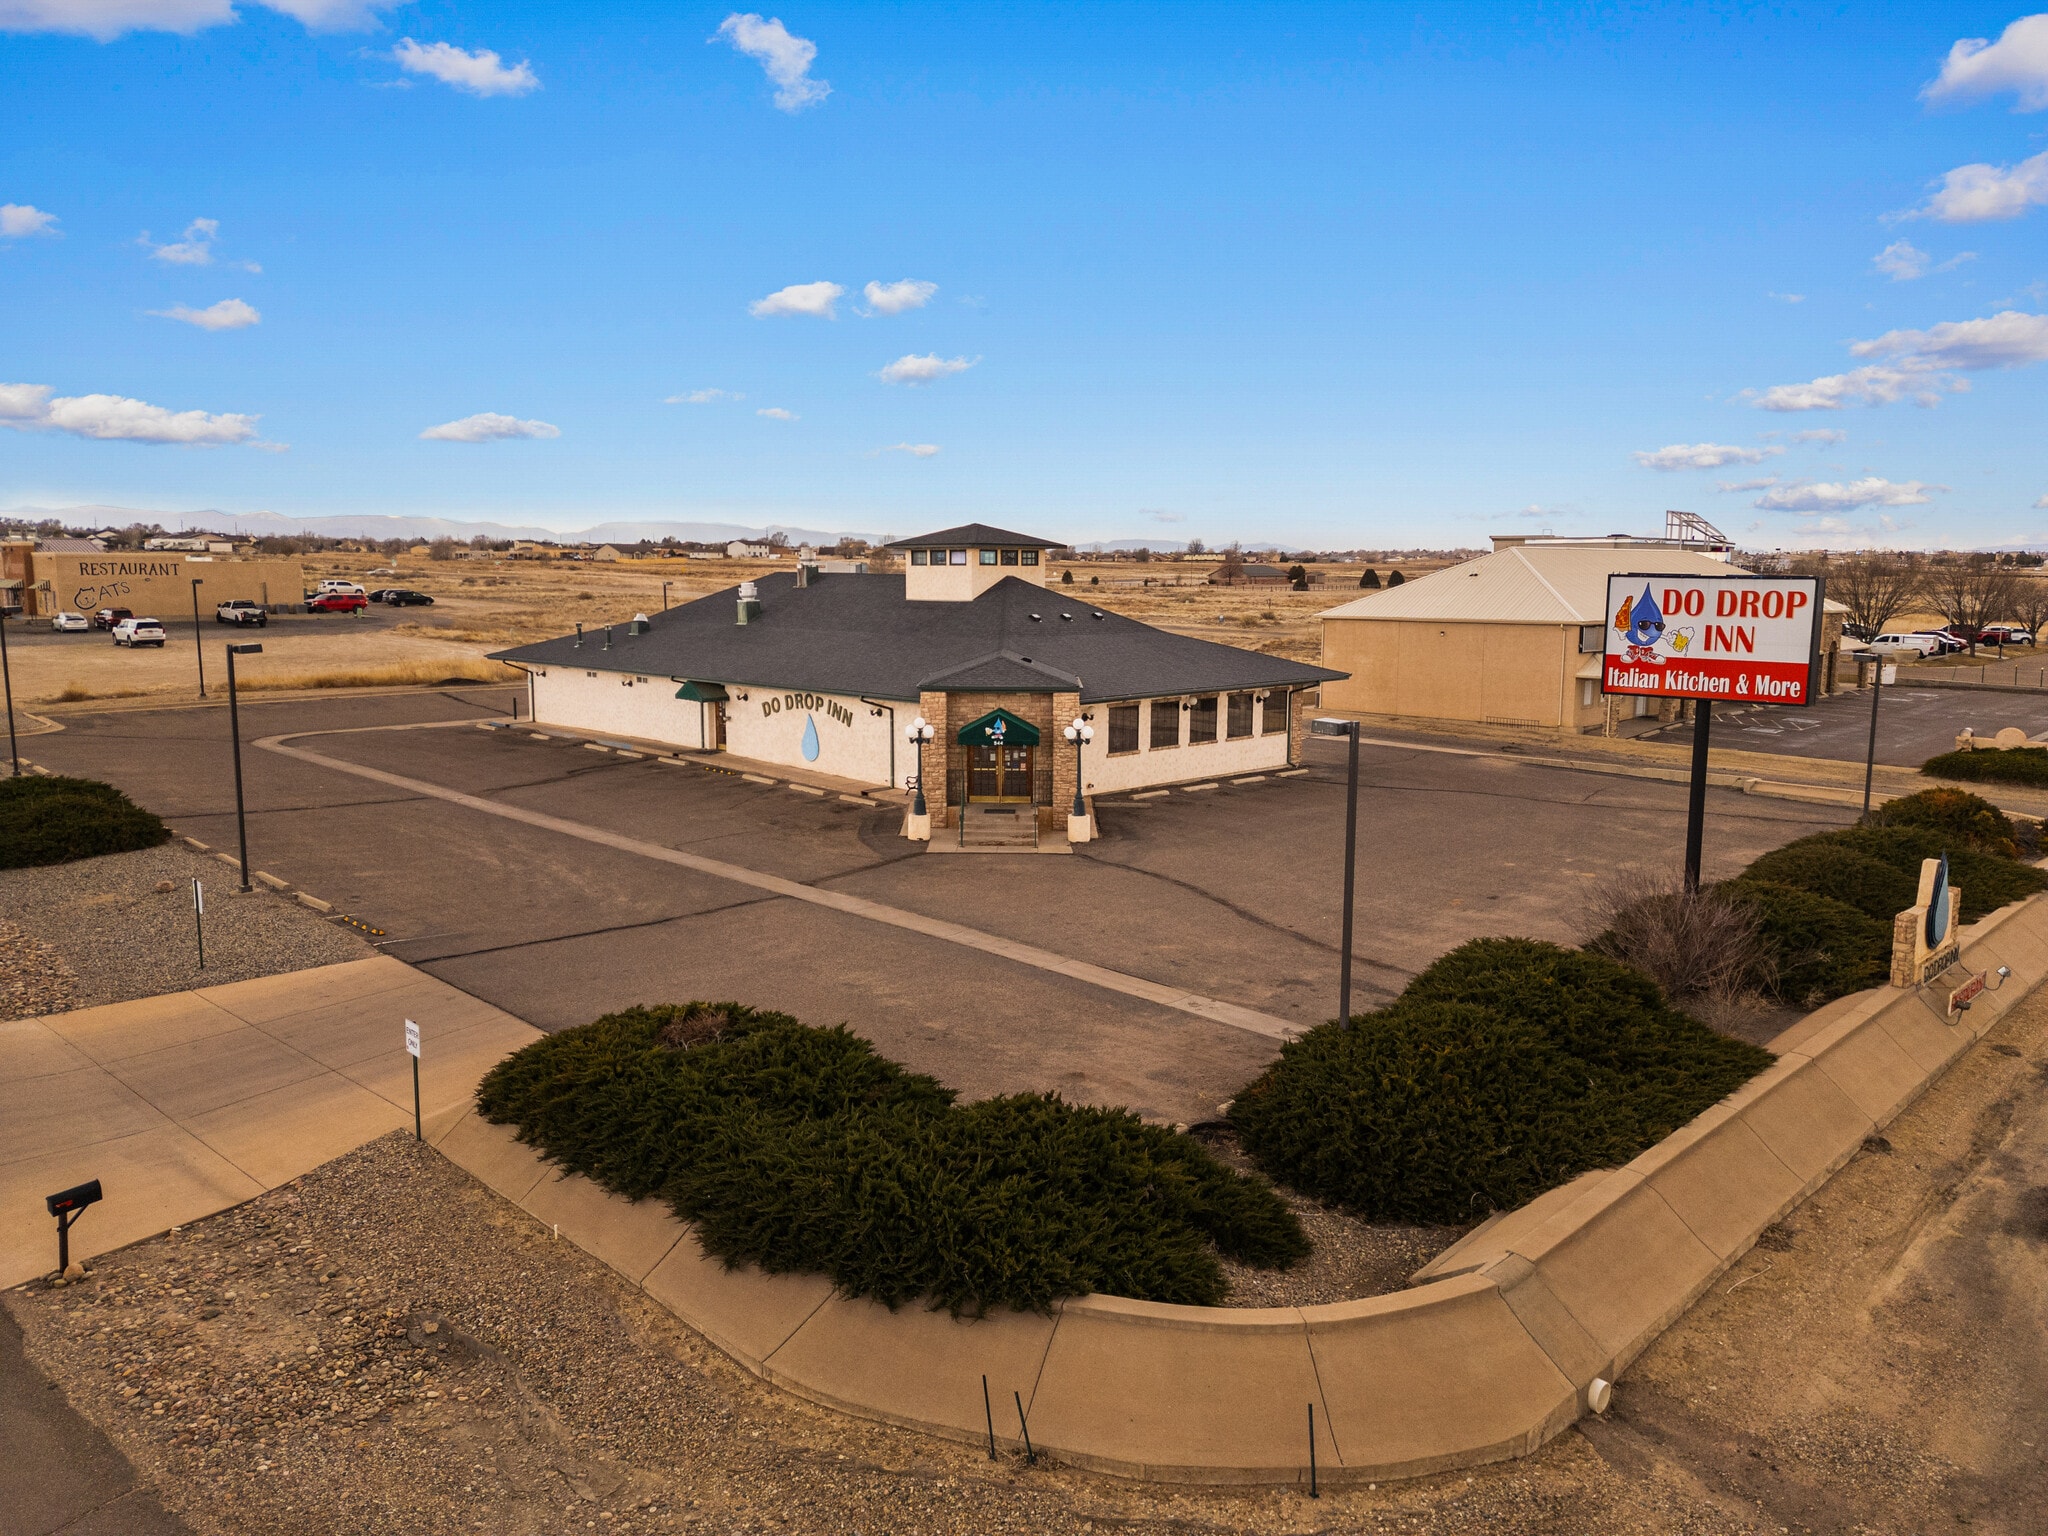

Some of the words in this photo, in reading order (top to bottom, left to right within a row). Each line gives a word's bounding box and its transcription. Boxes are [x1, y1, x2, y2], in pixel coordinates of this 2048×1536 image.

[79, 562, 179, 576] RESTAURANT
[1662, 588, 1705, 617] DO
[1716, 589, 1808, 620] DROP
[1703, 624, 1756, 654] INN
[1607, 666, 1660, 689] Italian
[1665, 670, 1730, 693] Kitchen
[1735, 674, 1750, 695] &
[1754, 674, 1801, 698] More
[761, 697, 781, 718] DO
[784, 693, 824, 712] DROP
[826, 699, 853, 728] INN
